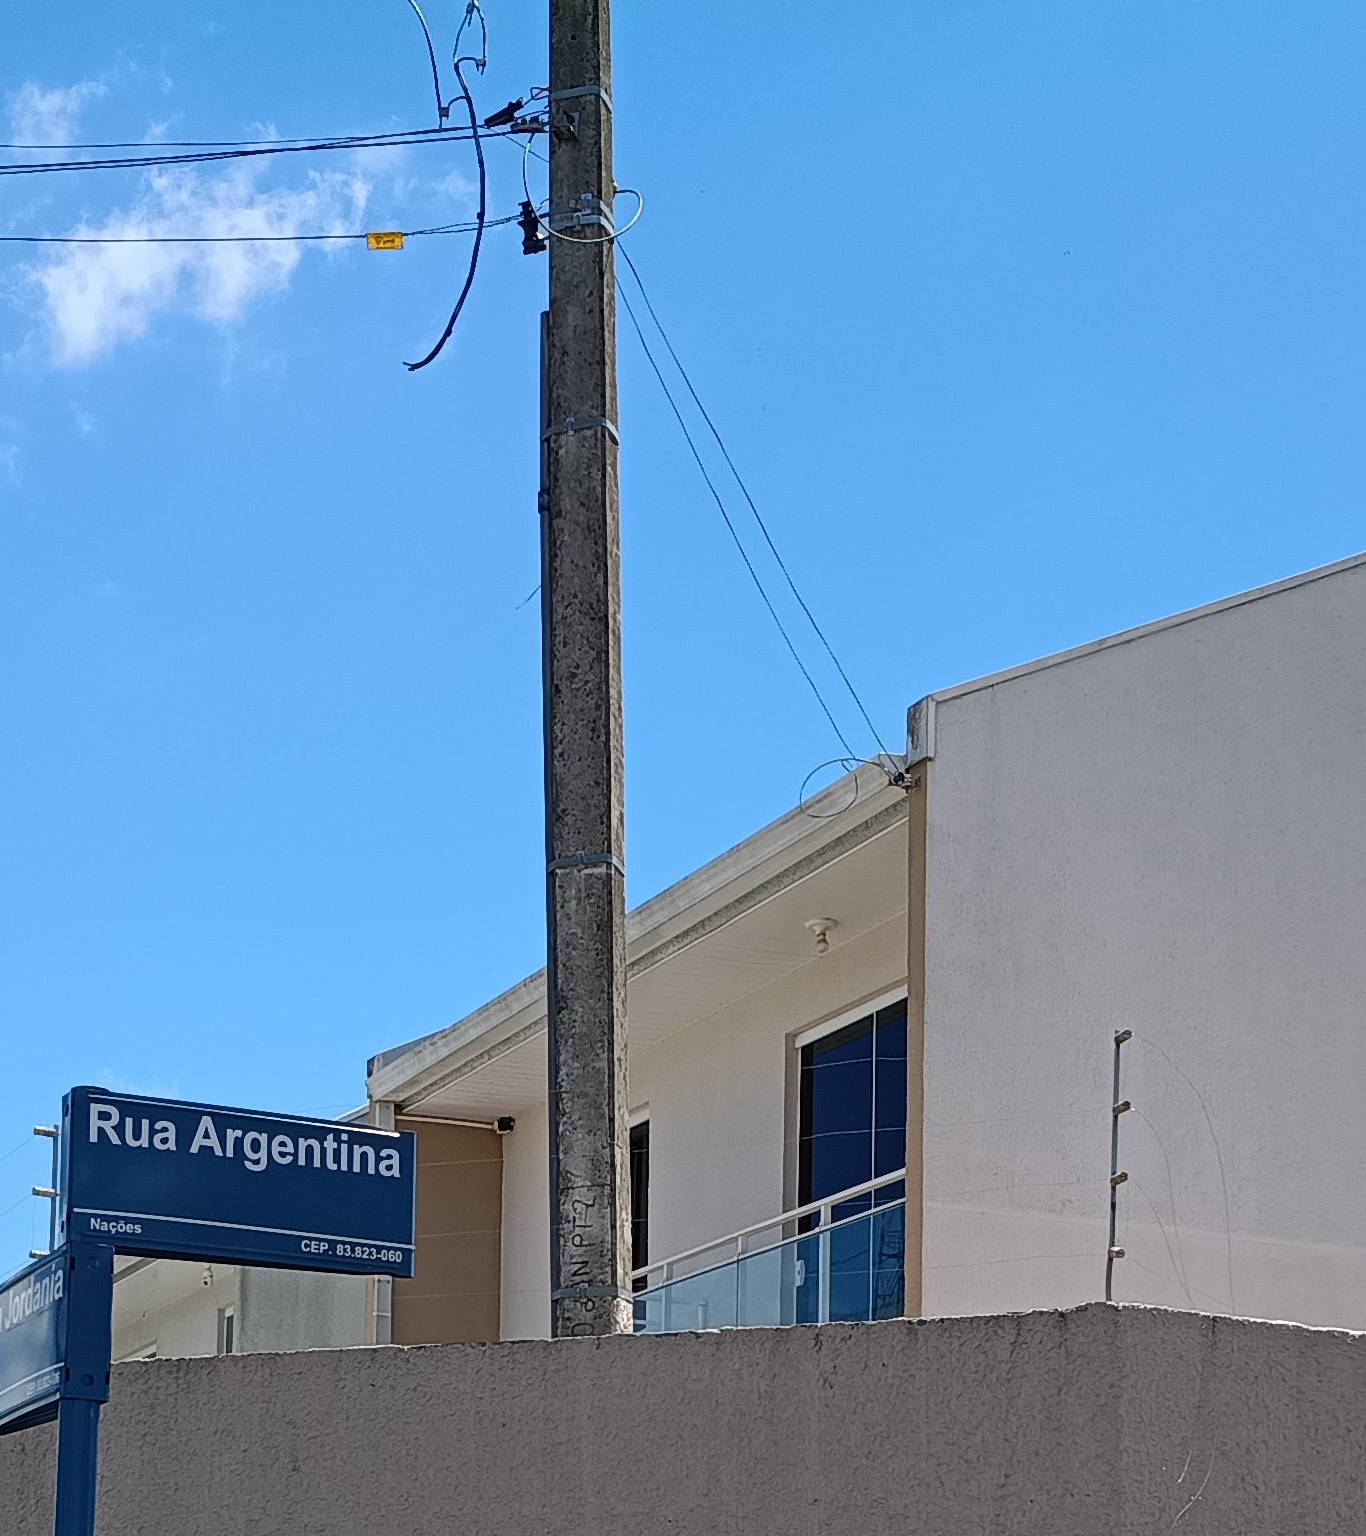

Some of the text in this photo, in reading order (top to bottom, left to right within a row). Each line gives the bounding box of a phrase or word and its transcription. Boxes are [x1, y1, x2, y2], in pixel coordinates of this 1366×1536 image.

[89, 1103, 401, 1178] Rua Argentina
[89, 1217, 143, 1235] Nações
[300, 1239, 403, 1263] CEP. 83.823-060
[5, 1263, 64, 1330] Jordania
